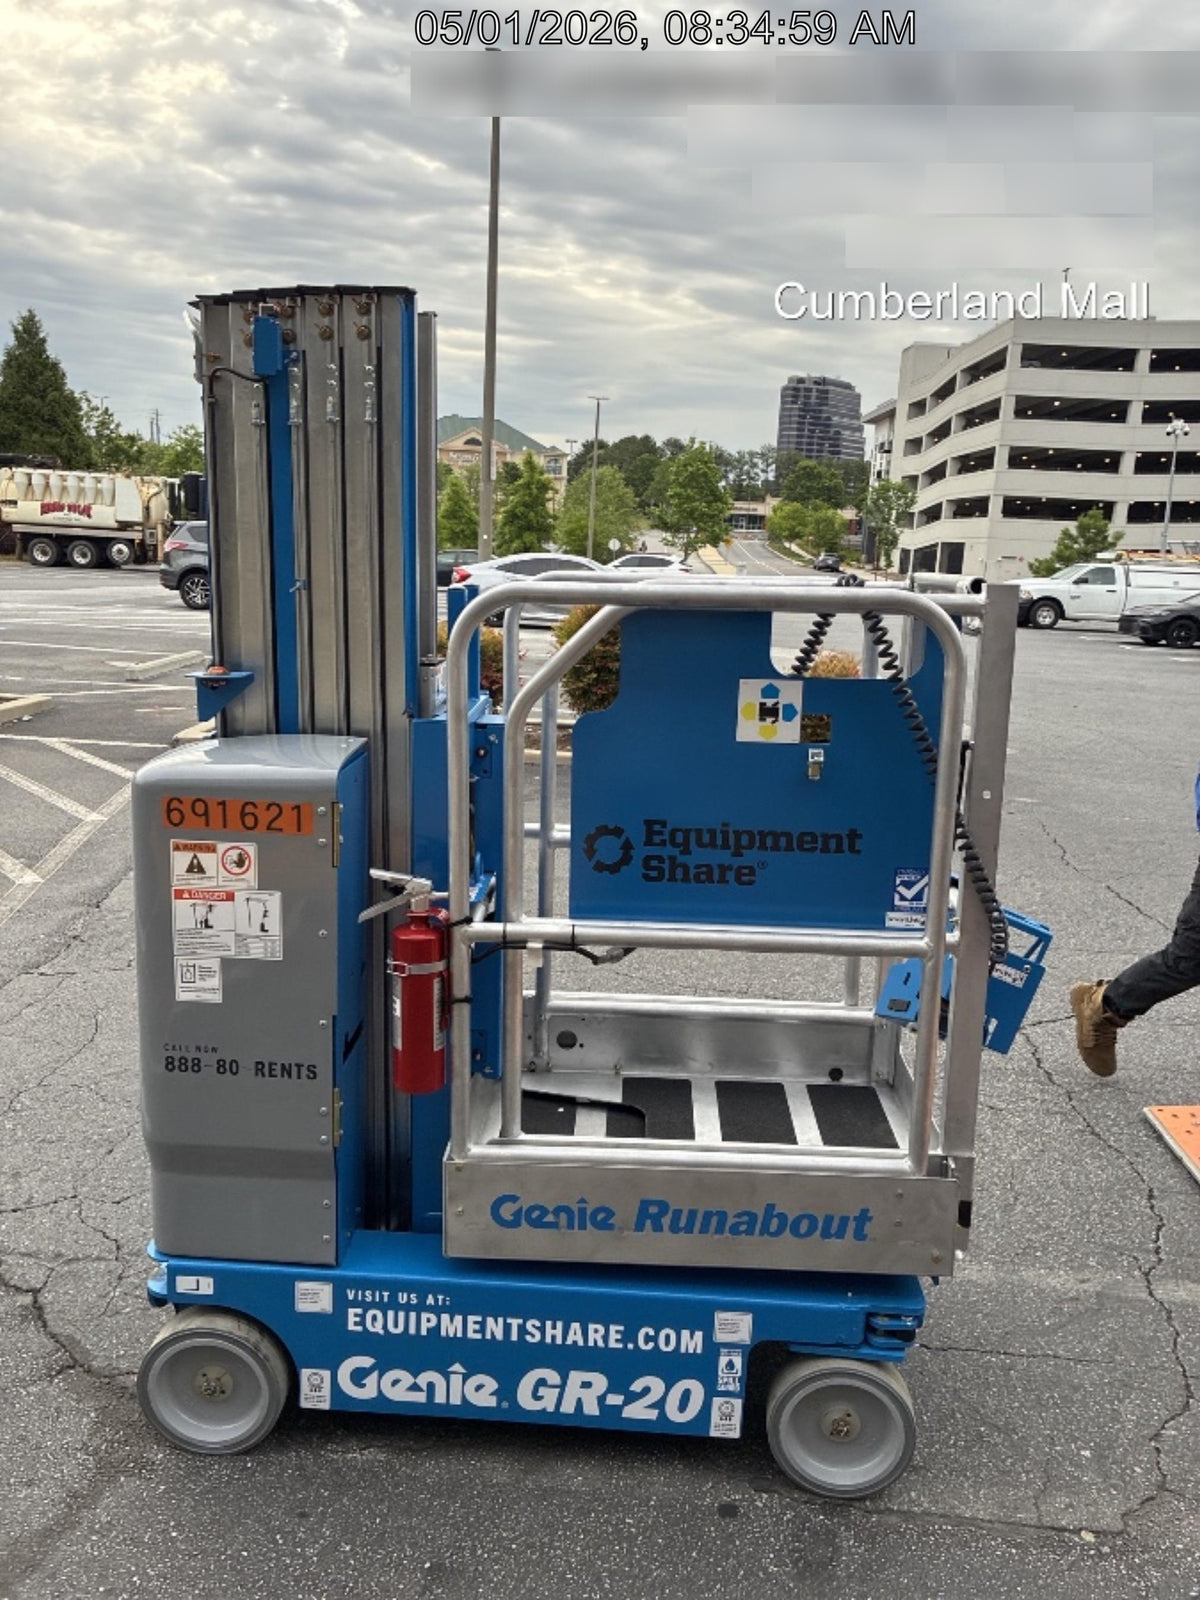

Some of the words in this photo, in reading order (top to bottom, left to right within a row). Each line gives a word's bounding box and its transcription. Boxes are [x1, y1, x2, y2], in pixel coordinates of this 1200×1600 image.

[165, 797, 304, 833] 691621
[642, 819, 863, 857] Equipment
[490, 1194, 615, 1231] Genie
[633, 1198, 874, 1242] Runabout
[346, 1288, 391, 1303] VISIT
[398, 1292, 418, 1305] US
[426, 1294, 451, 1306] AT:
[347, 1307, 704, 1355] EQUIPMENTSHARE.COM
[336, 1355, 500, 1408] Genie
[516, 1367, 706, 1424] GR-20
